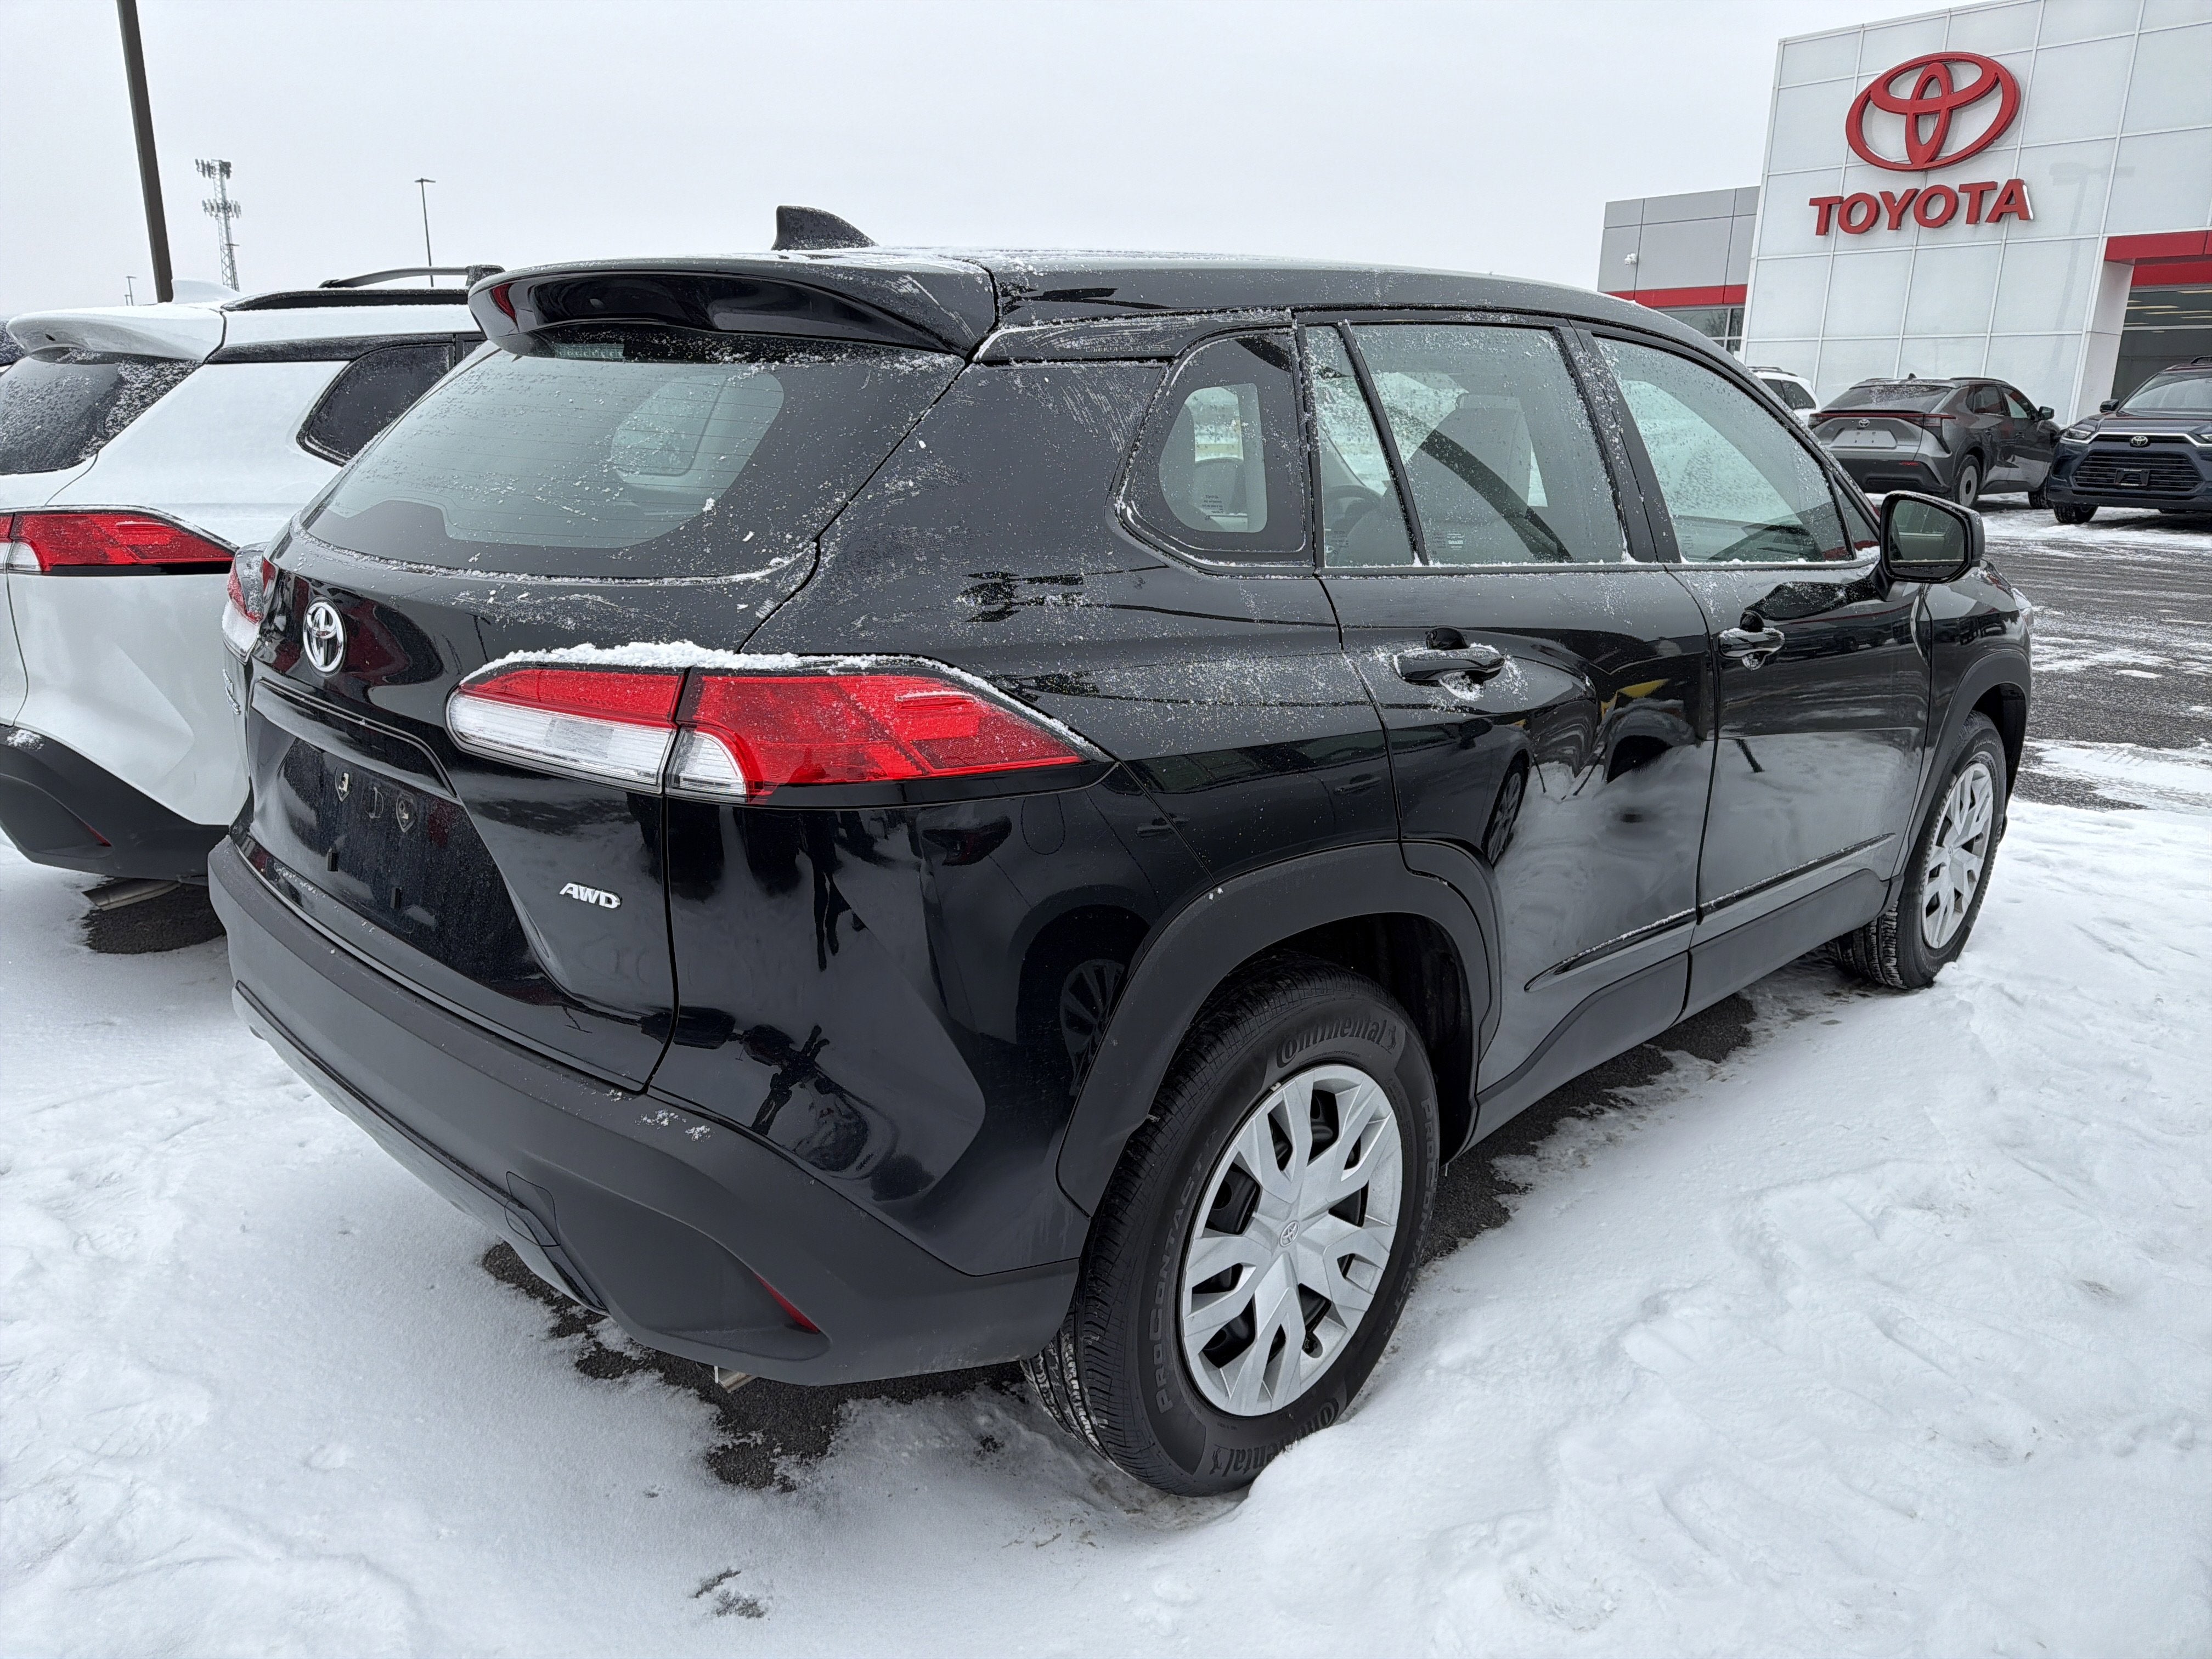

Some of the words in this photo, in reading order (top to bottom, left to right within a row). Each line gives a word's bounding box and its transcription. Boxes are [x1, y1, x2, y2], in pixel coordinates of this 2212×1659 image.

[1809, 178, 2034, 236] TOYOTA
[559, 882, 621, 909] AWD
[1276, 1014, 1387, 1068] Continental
[1149, 1156, 1203, 1414] PROCONTACT
